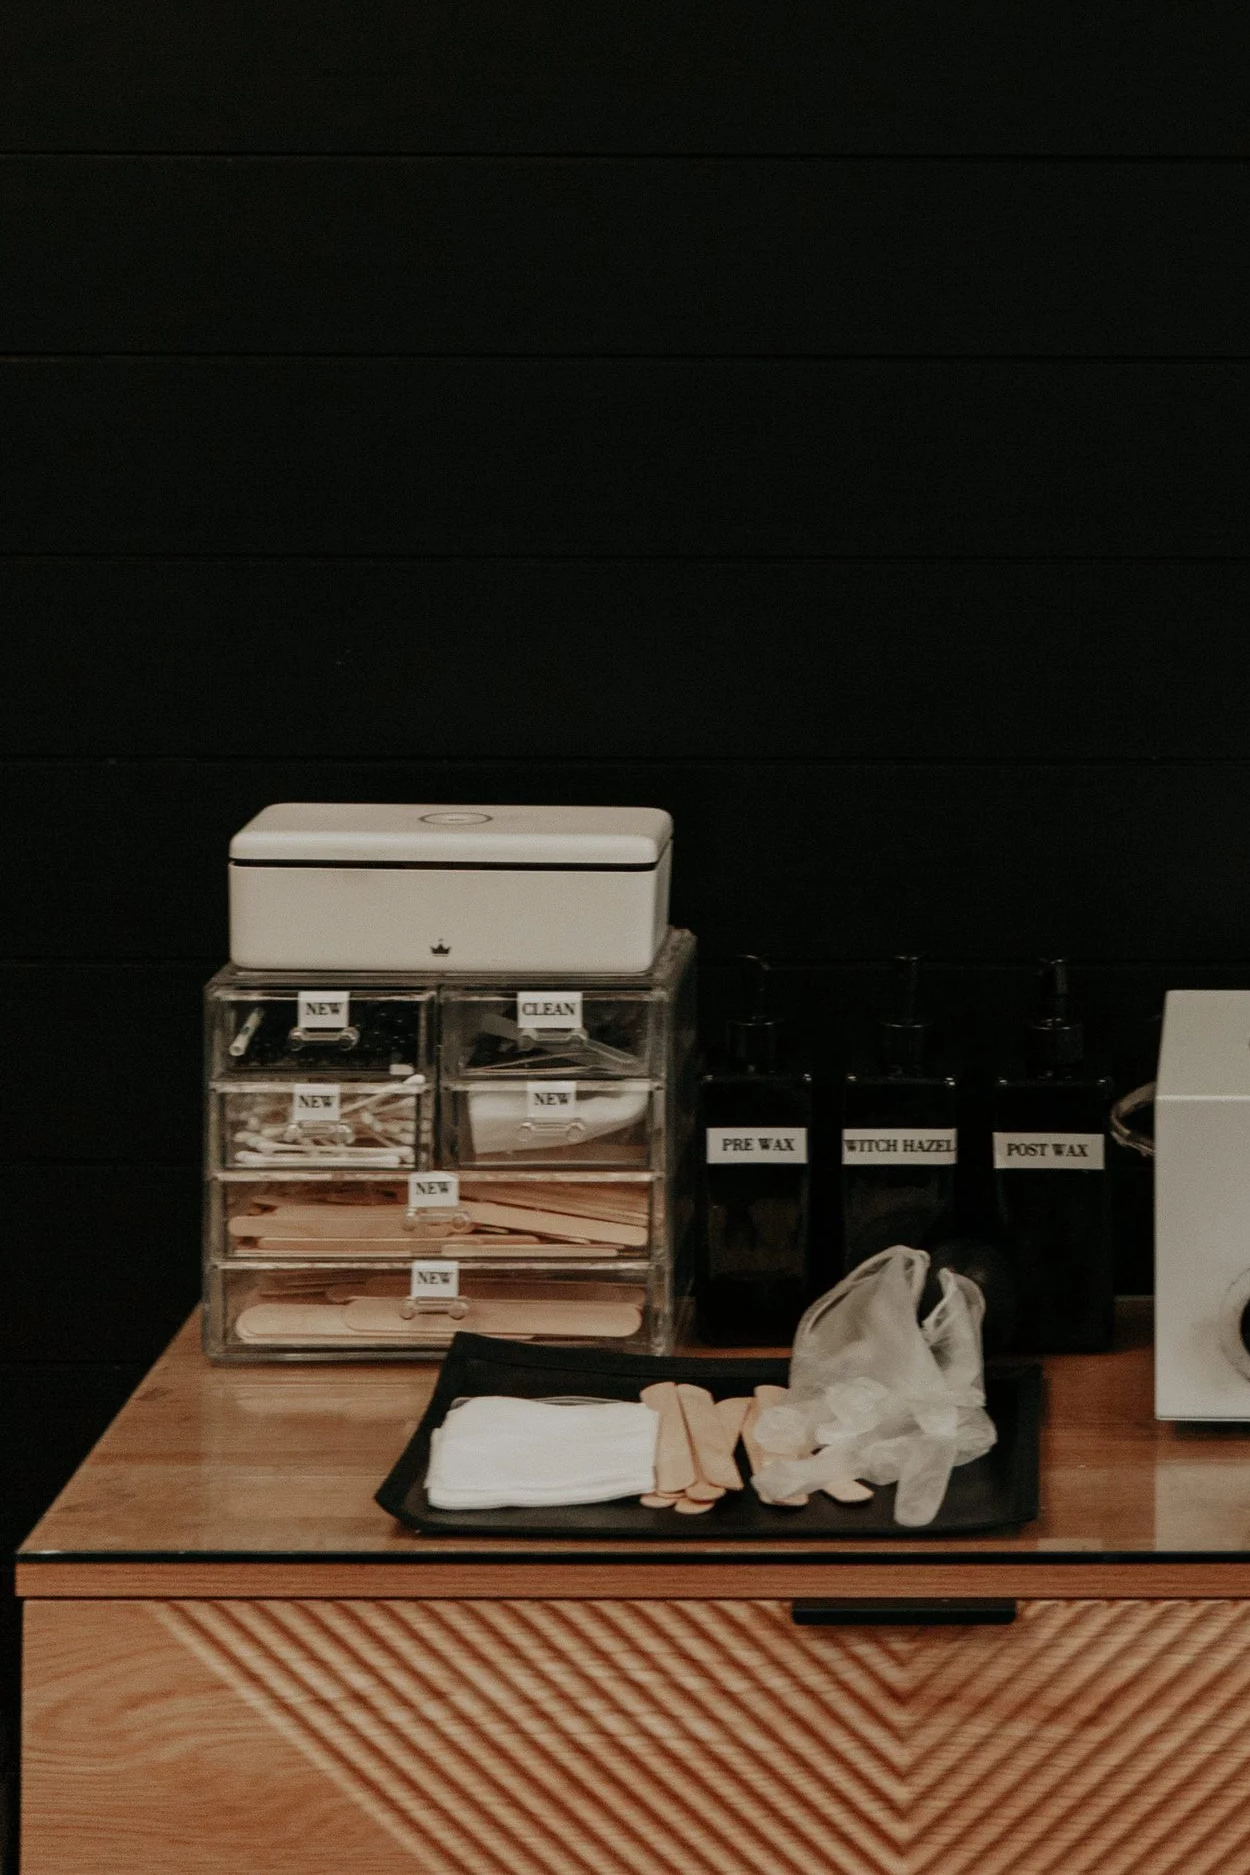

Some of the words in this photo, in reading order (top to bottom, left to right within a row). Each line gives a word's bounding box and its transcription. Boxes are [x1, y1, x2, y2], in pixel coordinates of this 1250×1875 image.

[305, 1002, 343, 1016] NEW
[521, 1002, 576, 1016] CLEAN
[298, 1095, 335, 1109] NEW
[533, 1093, 570, 1106] NEW
[722, 1138, 754, 1152] PRE
[758, 1138, 796, 1152] WAX
[843, 1139, 898, 1153] WITCH
[902, 1139, 957, 1153] HAZEL
[1007, 1143, 1048, 1158] POST
[1053, 1143, 1089, 1158] WAX
[415, 1181, 451, 1195] NEW
[416, 1271, 452, 1285] NEW
